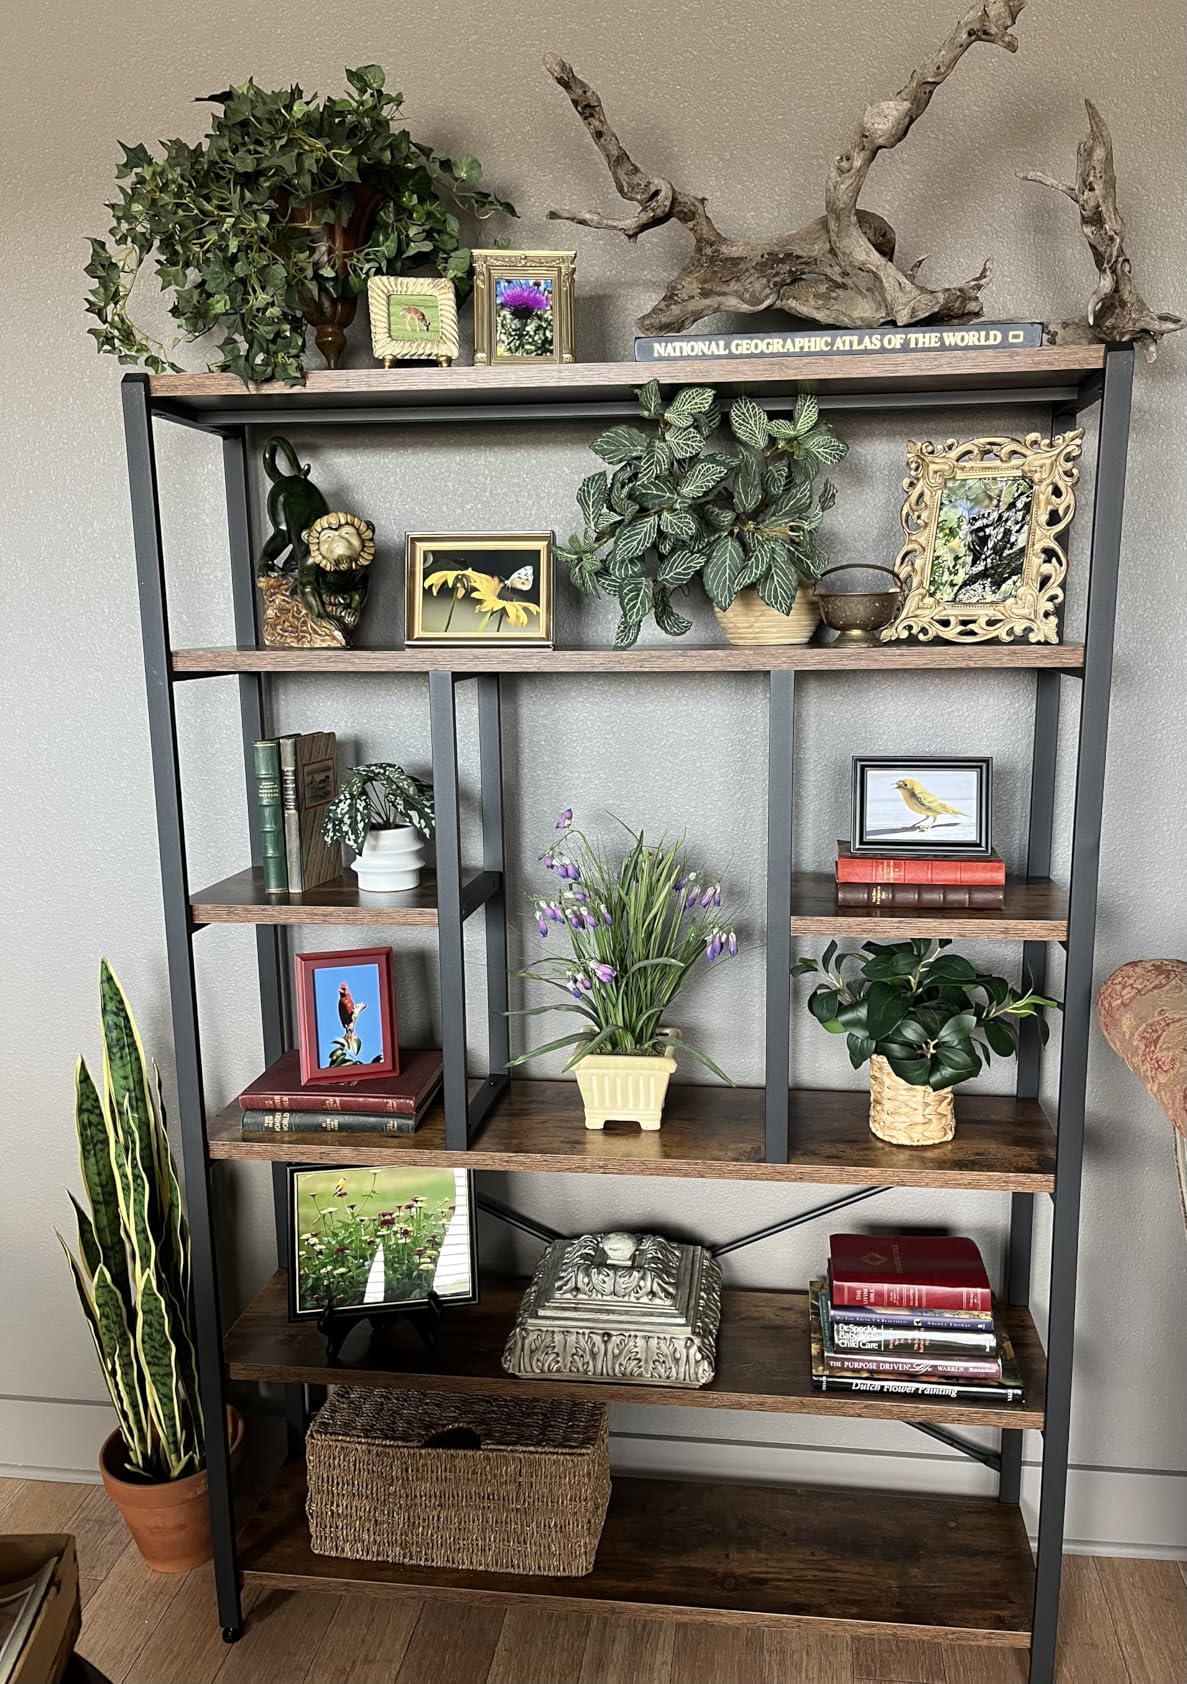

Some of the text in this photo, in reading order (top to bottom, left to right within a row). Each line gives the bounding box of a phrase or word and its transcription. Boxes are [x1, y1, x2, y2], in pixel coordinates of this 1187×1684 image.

[653, 330, 1002, 357] NATIONAL GEOGRAPHIC ATLAS OF THE WORLD
[838, 1339, 879, 1349] Child Care
[844, 1361, 877, 1370] PURPOSE
[937, 1364, 964, 1372] WARREN
[852, 1381, 958, 1398] Dutch Flower Painting
